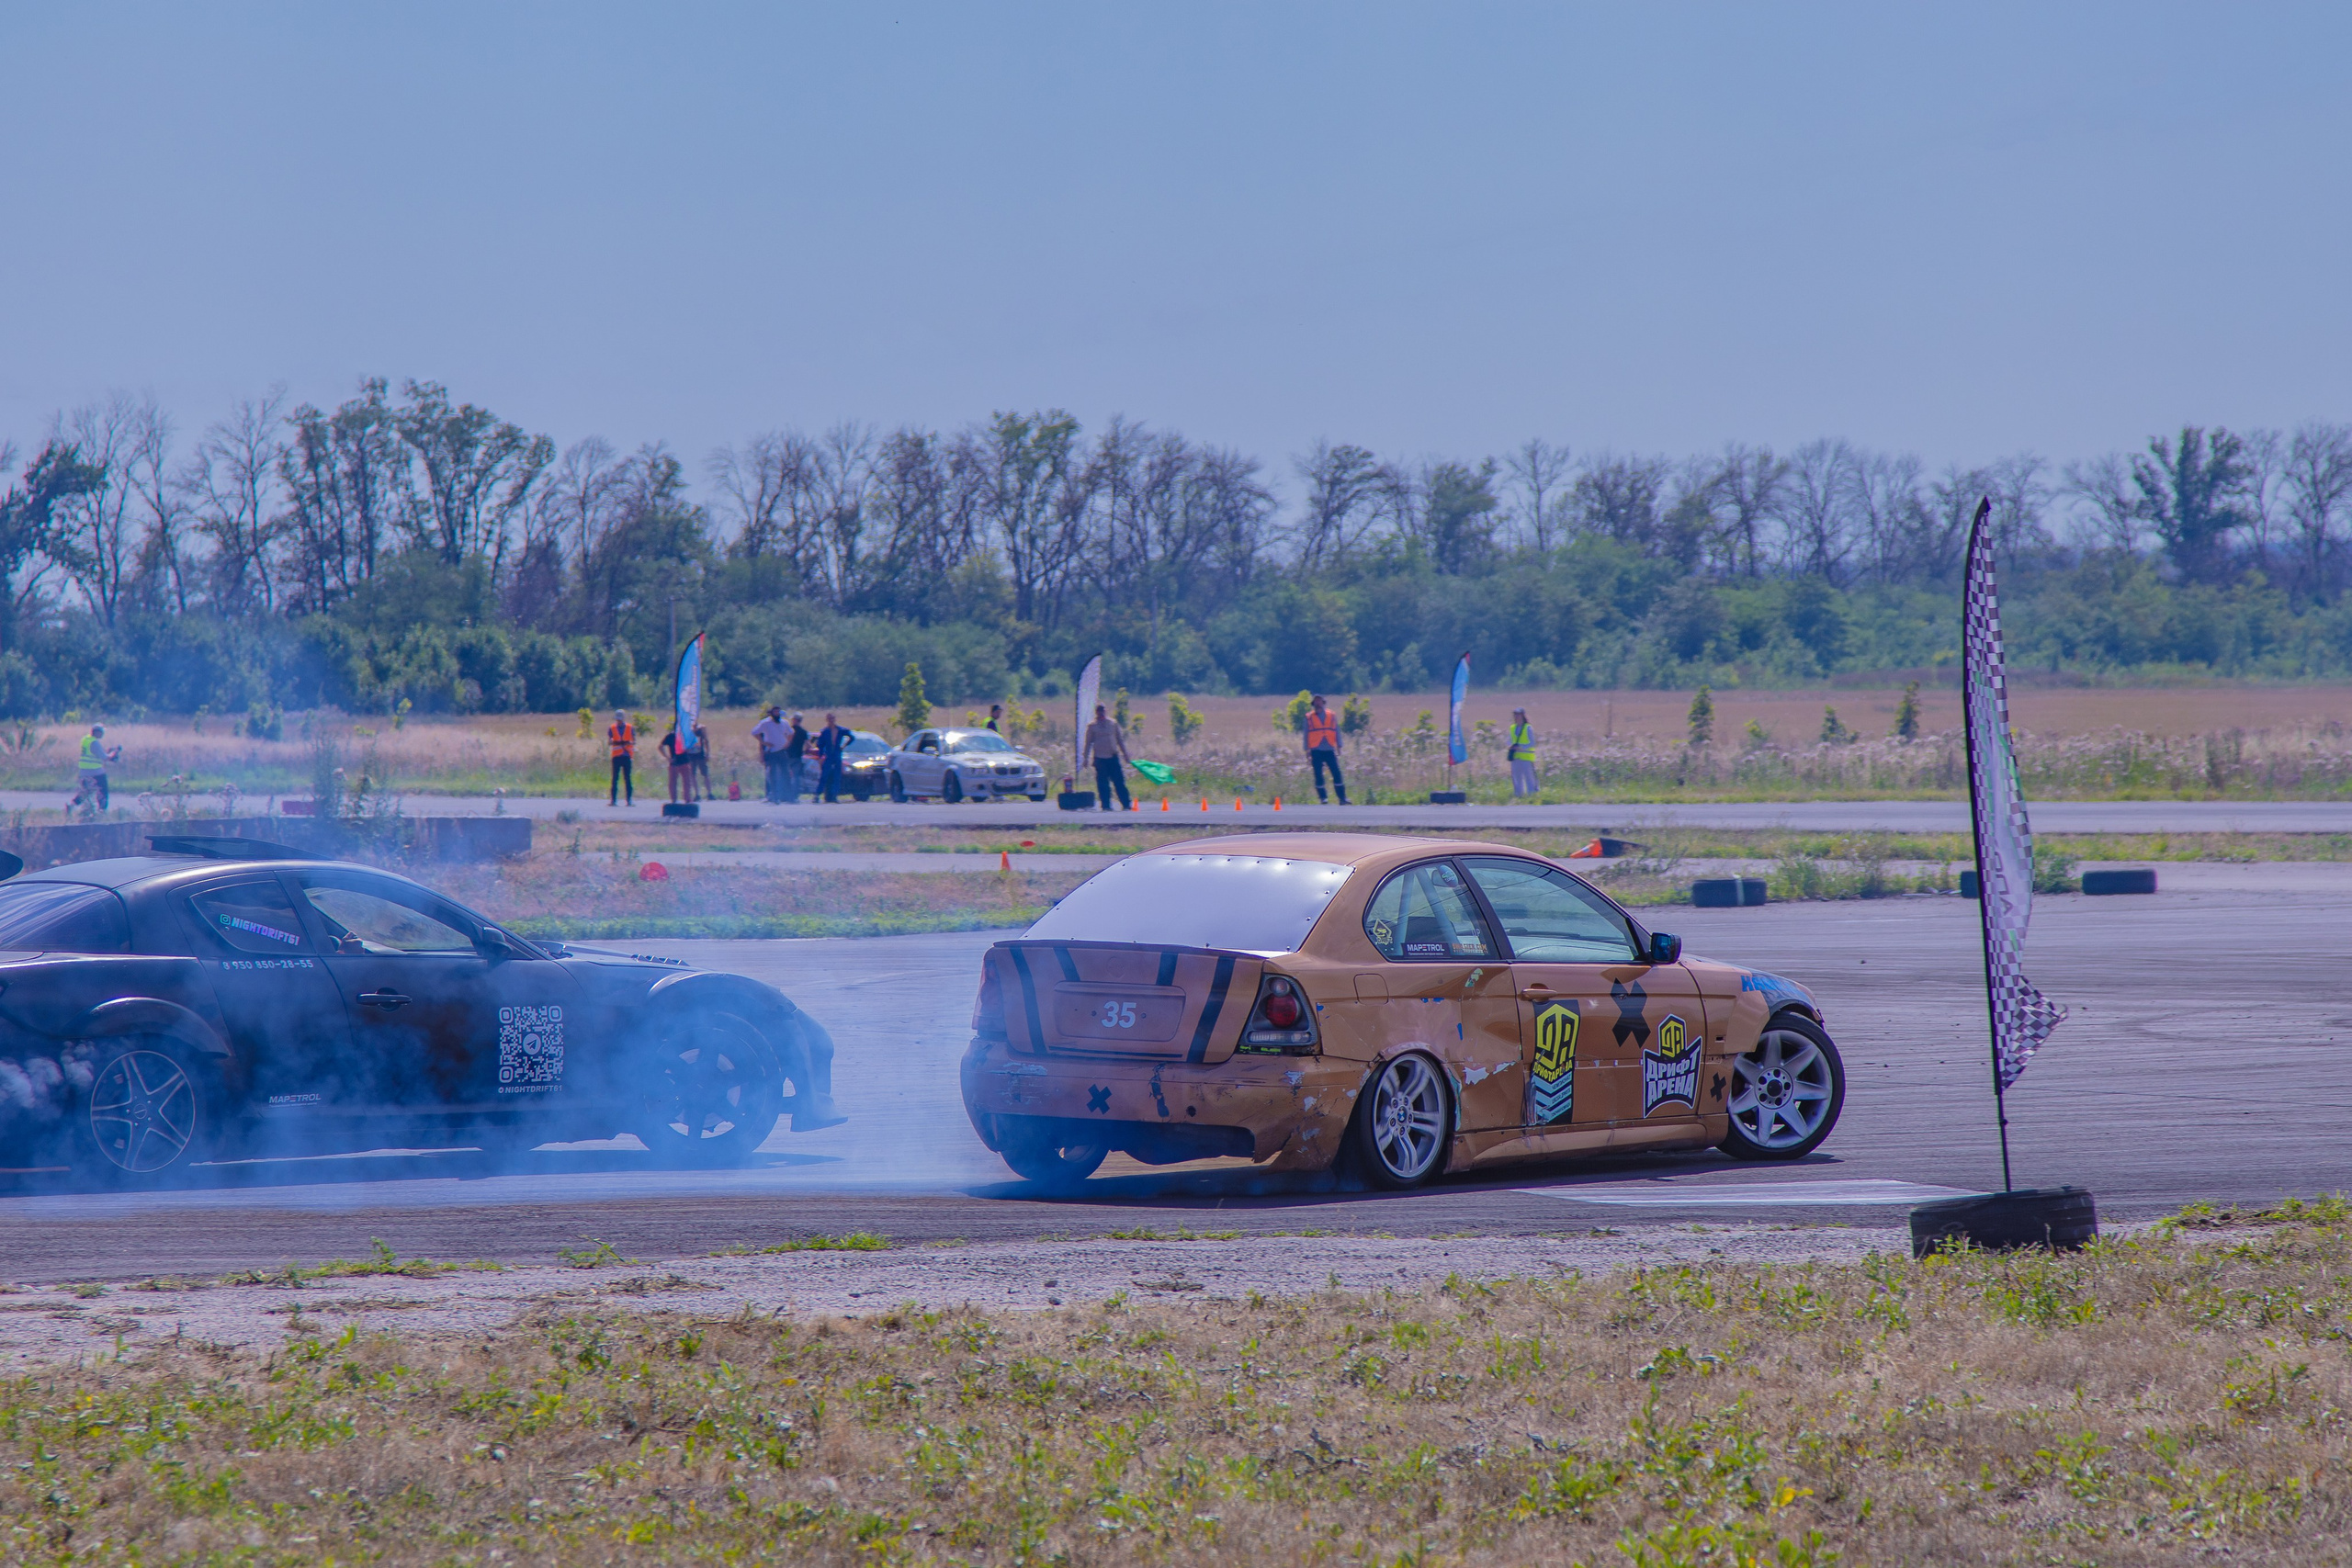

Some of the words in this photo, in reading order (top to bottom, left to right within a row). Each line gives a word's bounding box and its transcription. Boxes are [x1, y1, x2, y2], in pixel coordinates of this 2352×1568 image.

[232, 917, 300, 945] NIGHTDRIFT61
[1407, 943, 1445, 952] MAPETROL
[222, 961, 230, 970] 8
[232, 961, 253, 970] 950
[254, 959, 314, 969] 850-28-55
[1101, 1000, 1136, 1029] 35
[1646, 1044, 1701, 1082] ДРИФТ
[268, 1093, 322, 1103] MAPETROL
[1647, 1072, 1695, 1108] АРЕНА
